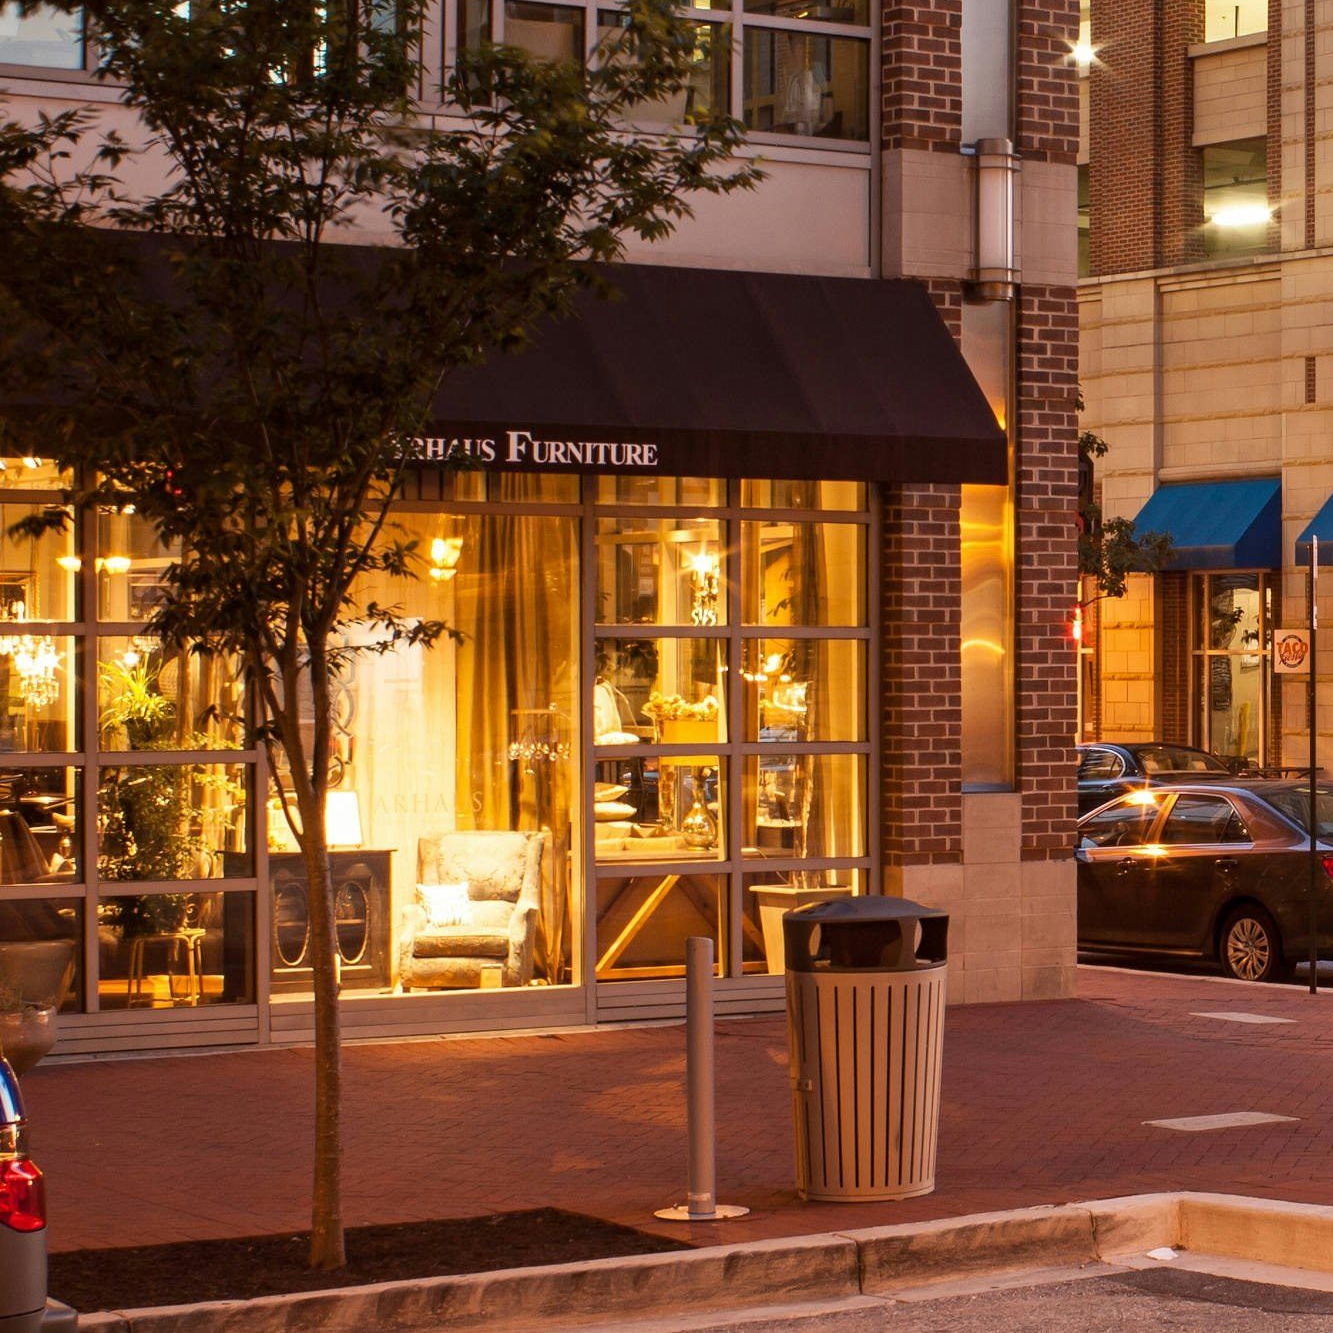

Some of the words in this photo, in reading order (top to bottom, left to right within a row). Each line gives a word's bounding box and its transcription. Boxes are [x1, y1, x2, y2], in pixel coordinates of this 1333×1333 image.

[505, 430, 659, 466] FURNITURE
[1276, 641, 1309, 654] TACO
[374, 791, 484, 814] ARHAS
